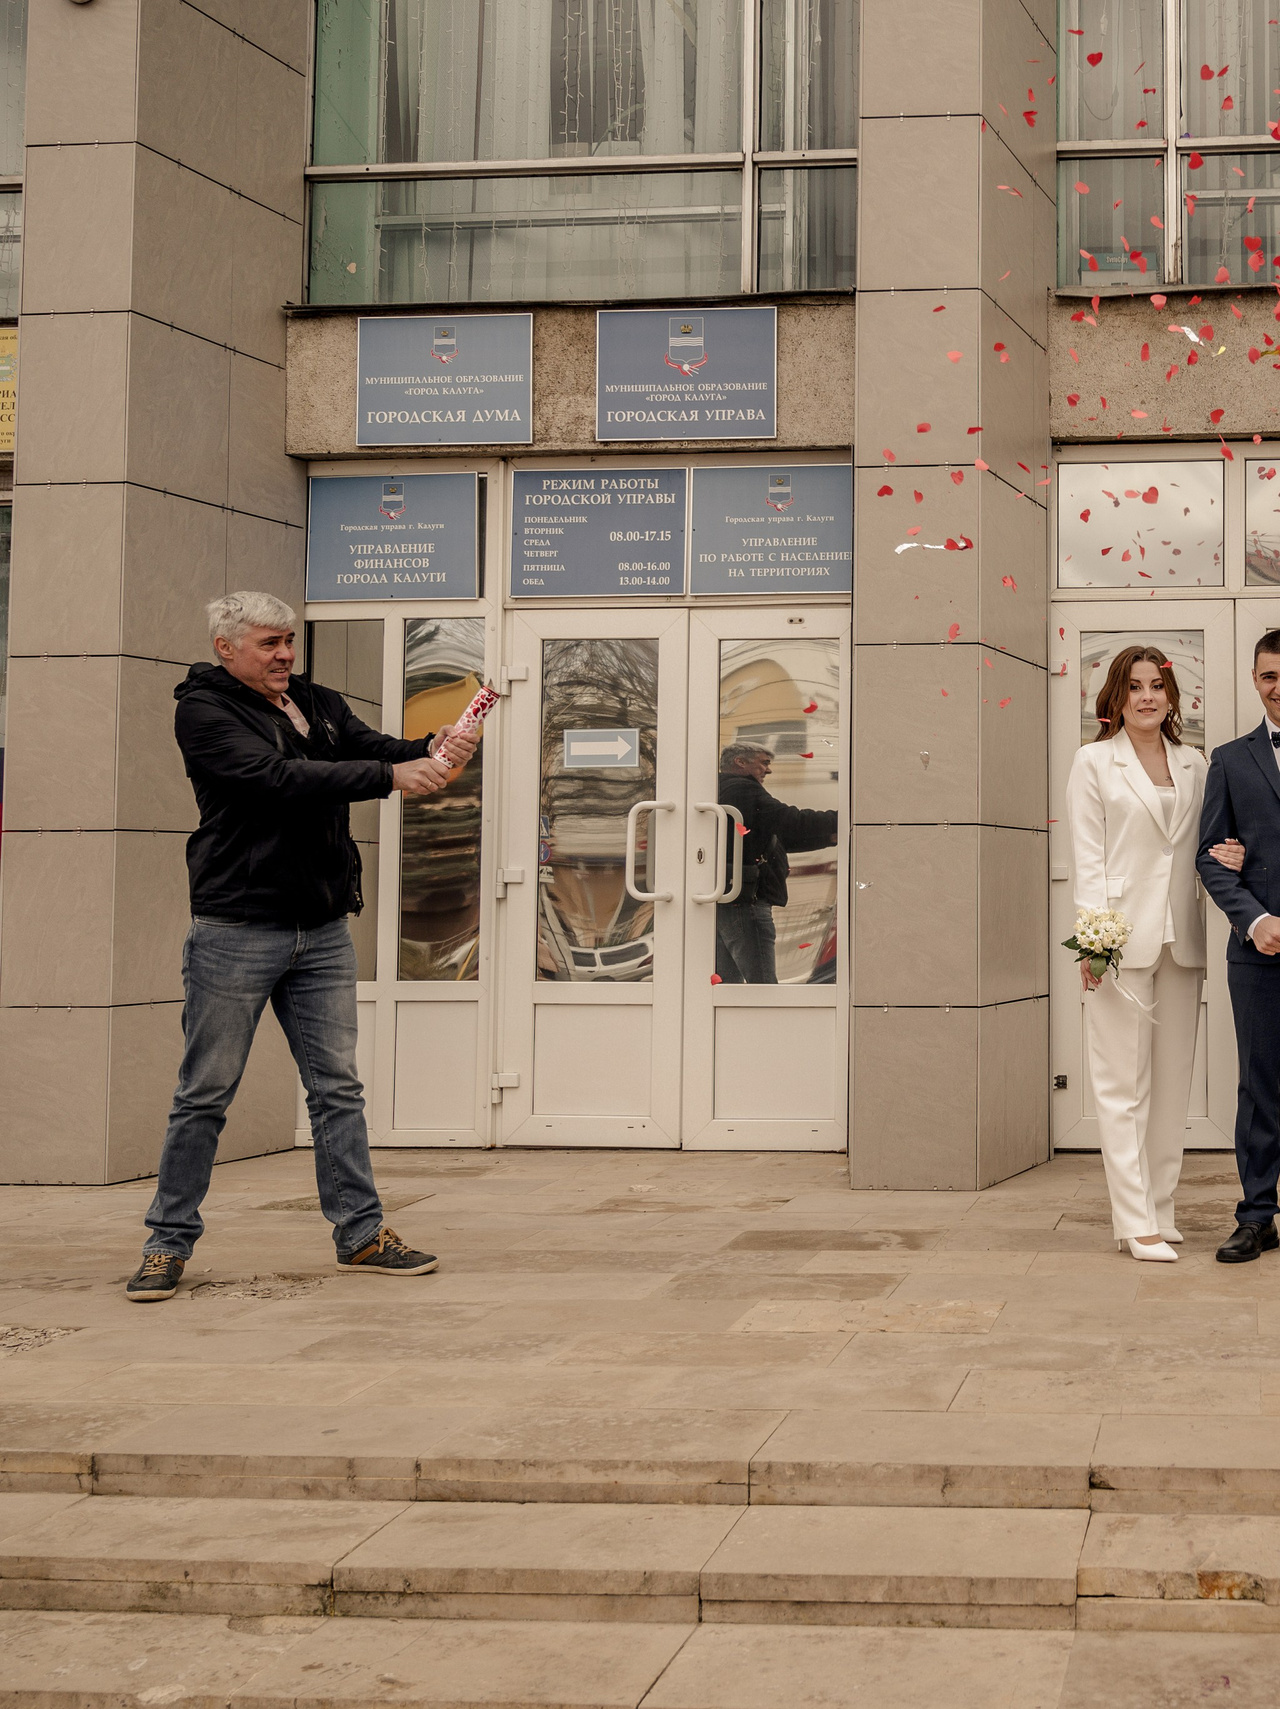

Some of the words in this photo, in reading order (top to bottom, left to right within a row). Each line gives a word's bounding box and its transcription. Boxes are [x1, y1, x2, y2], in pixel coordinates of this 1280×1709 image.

[365, 375, 452, 385] МУНИЦИПАЛЬНОЕ
[455, 374, 524, 384] ОБРАЗОВАНИЕ
[404, 387, 439, 396] «ГОРОД
[442, 386, 485, 395] КАЛУГА»
[605, 384, 694, 393] МУНИЦИПАЛЬНОЕ
[698, 382, 768, 392] ОБРАЗОВАНИЕ
[645, 394, 681, 402] «ГОРОД
[684, 393, 727, 401] КАЛУГА»
[366, 410, 466, 424] ГОРОДСКАЯ
[472, 409, 522, 423] ДУМА
[606, 410, 699, 423] ГОРОДСКАЯ
[704, 409, 766, 422] УПРАВА
[542, 479, 595, 491] РЕЖИМ
[600, 478, 659, 490] РАБОТЫ
[525, 493, 612, 506] ГОРОДСКОЙ
[617, 493, 676, 505] УПРАВЫ
[524, 516, 588, 524] ПОНЕДЕЛЬНИК
[725, 515, 765, 524] Городская
[767, 516, 794, 524] управа
[806, 514, 835, 523] Калуги
[340, 524, 378, 532] Городская
[380, 524, 406, 532] управа
[417, 522, 445, 531] Калуги
[524, 527, 565, 535] ВТОРНИК
[609, 530, 672, 542] 08.00-17.15
[742, 536, 818, 547] УПРАВЛЕНИЕ
[349, 543, 435, 555] УПРАВЛЕНИЕ
[524, 550, 559, 558] ЧЕТВЕРГ
[699, 553, 717, 563] ПО
[720, 552, 764, 562] РАБОТЕ
[768, 552, 777, 562] С
[780, 551, 852, 562] НАСЕЛЕНИЕ
[354, 558, 430, 569] ФИНАНСОВ
[523, 564, 566, 572] ПЯТНИЦА
[618, 561, 671, 571] 08.00-16.00
[728, 568, 745, 577] НА
[749, 567, 830, 577] ТЕРРИТОРИЯХ
[336, 573, 388, 584] ГОРОДА
[393, 572, 447, 584] КАЛУГИ
[522, 578, 545, 586] ОБЕД
[619, 576, 670, 586] 13.00-14.00
